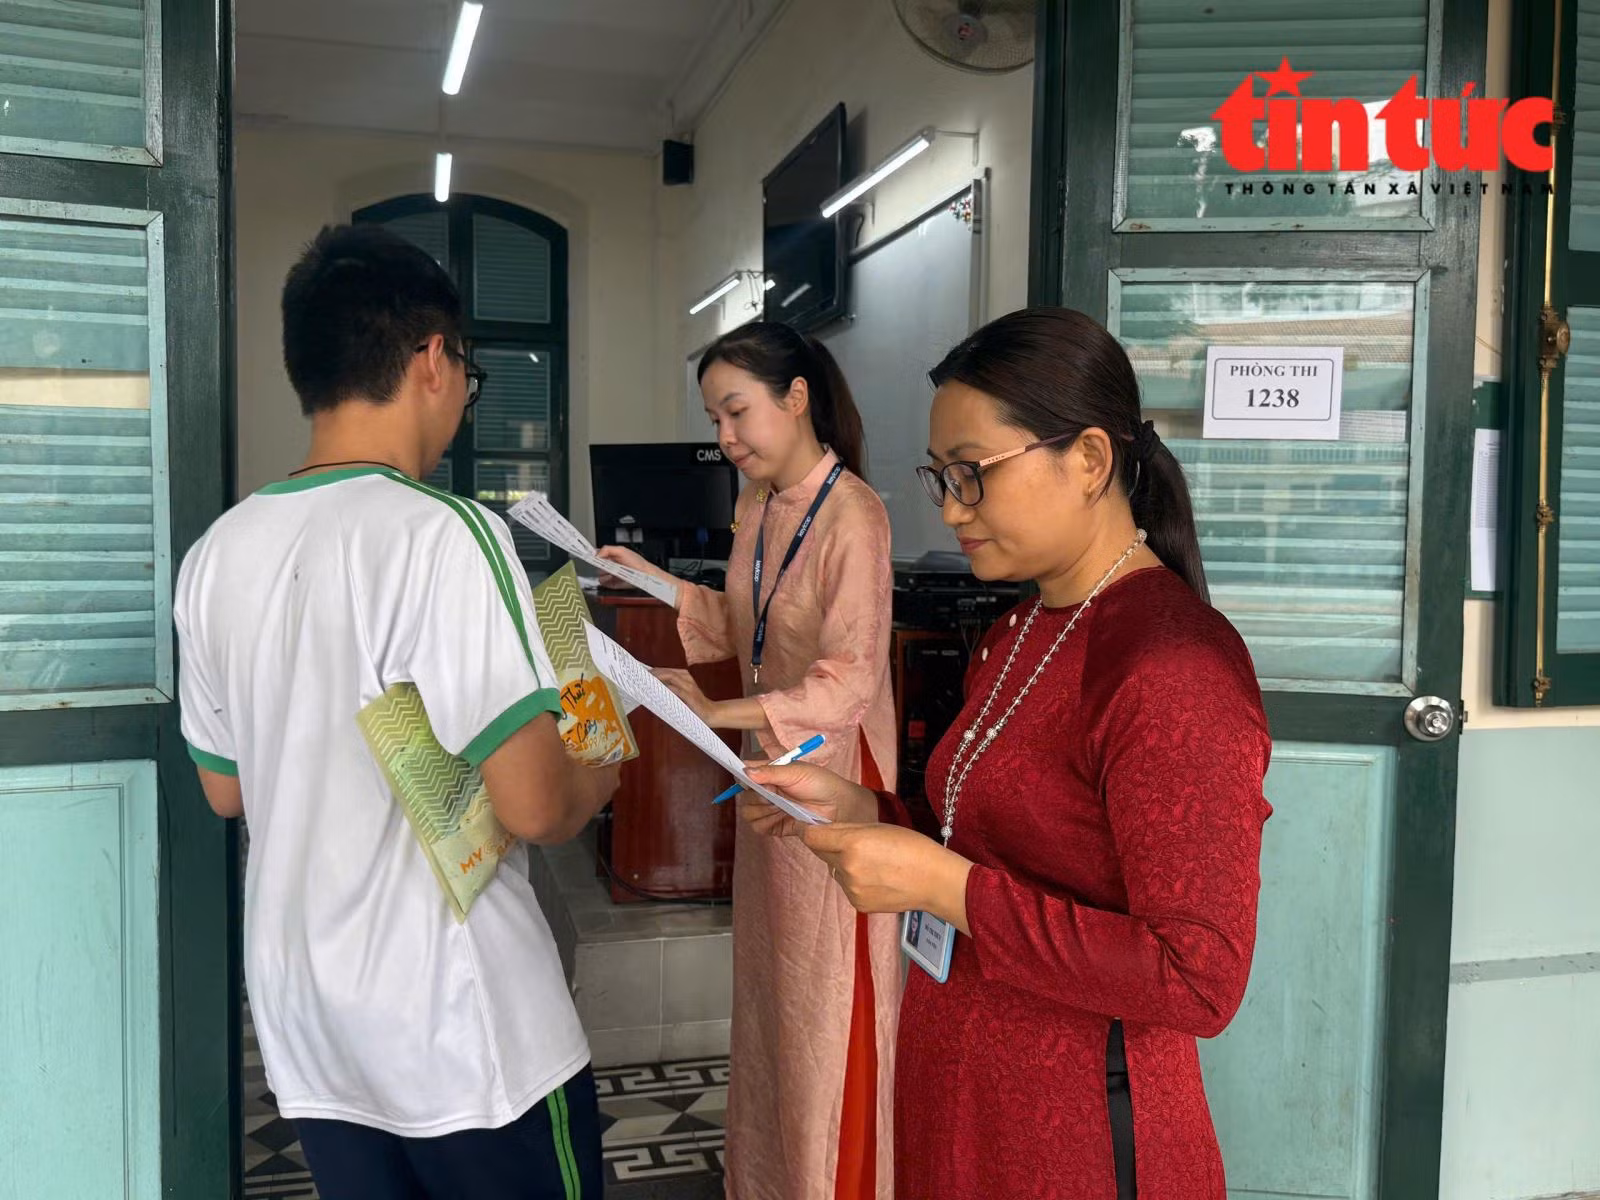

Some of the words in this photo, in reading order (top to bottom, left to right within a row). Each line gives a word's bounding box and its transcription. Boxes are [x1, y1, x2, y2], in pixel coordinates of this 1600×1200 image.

[1230, 362, 1285, 377] PHÒNG
[1290, 366, 1317, 377] THI
[1247, 388, 1300, 408] 1238
[696, 449, 722, 461] CMS
